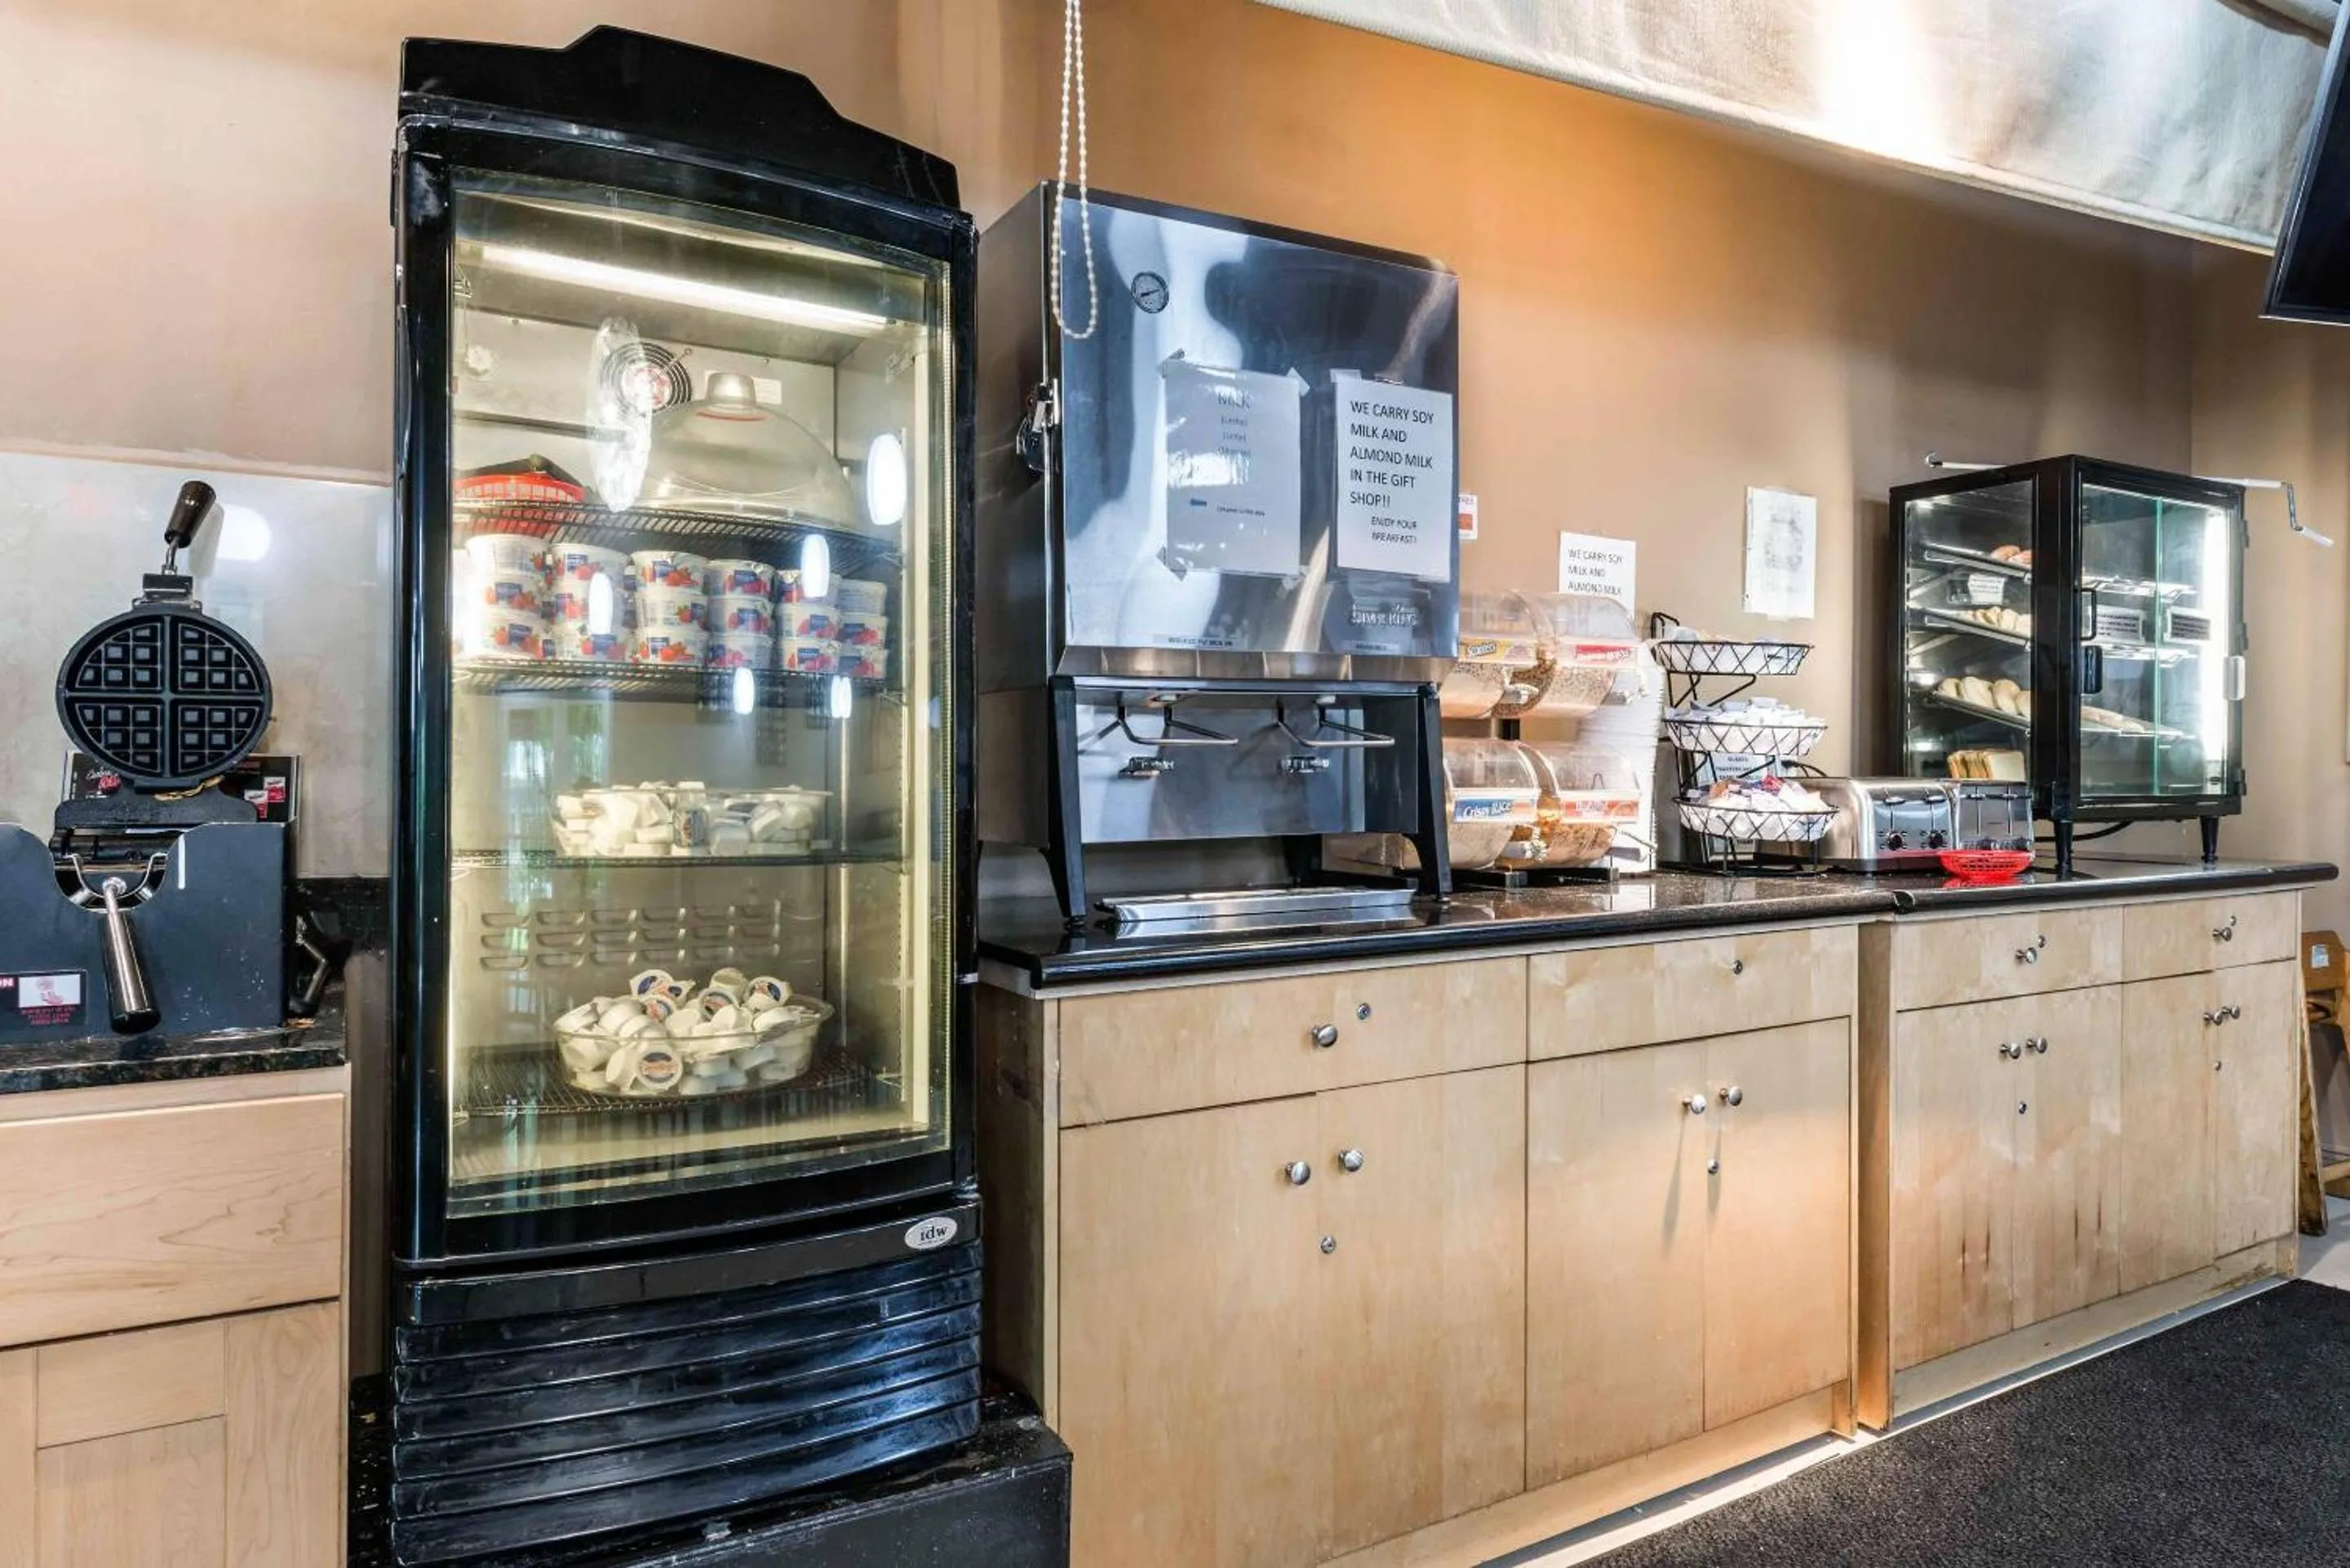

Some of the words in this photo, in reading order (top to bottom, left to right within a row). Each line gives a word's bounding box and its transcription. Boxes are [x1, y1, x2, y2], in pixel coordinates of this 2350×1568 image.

[1350, 401, 1369, 414] WE
[1372, 404, 1409, 420] CARRY
[1412, 410, 1434, 424] SOY
[1350, 423, 1379, 438] MILK
[1381, 427, 1408, 442] AND
[1350, 446, 1403, 464] ALMOND
[1404, 454, 1433, 468] MILK
[1350, 468, 1363, 482] IN
[1366, 471, 1388, 485] THE
[1390, 474, 1416, 488] GIFT
[920, 1225, 947, 1242] idw
